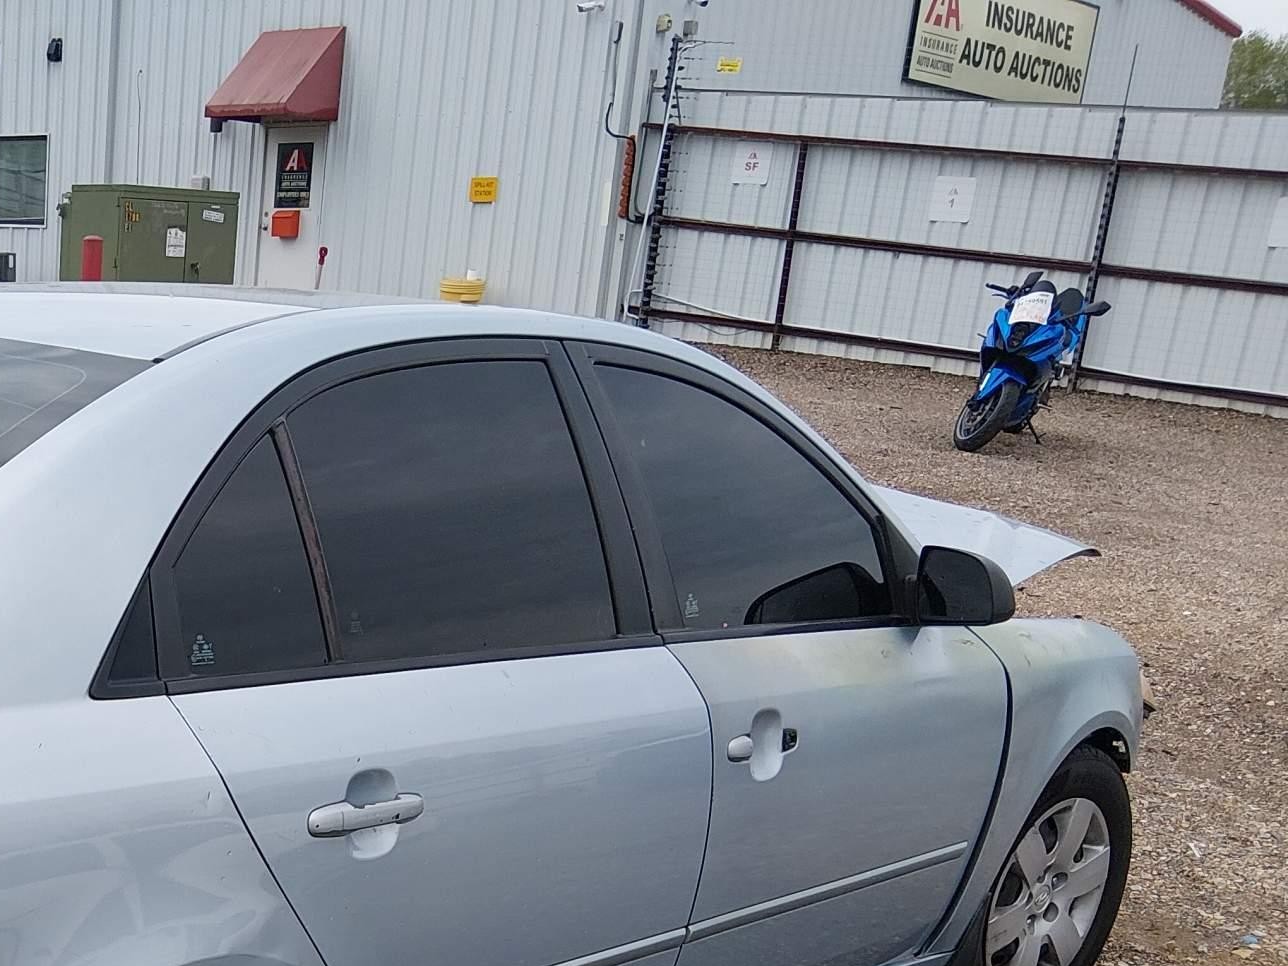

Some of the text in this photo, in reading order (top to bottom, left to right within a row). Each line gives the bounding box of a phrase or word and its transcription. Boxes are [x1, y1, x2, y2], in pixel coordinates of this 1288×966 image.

[985, 0, 1074, 51] INSURANCE
[920, 35, 958, 55] INSURANCE
[917, 55, 954, 73] AUTO AUCTIONS
[959, 37, 1082, 94] AUTO AUCTIONS
[745, 161, 759, 171] SF
